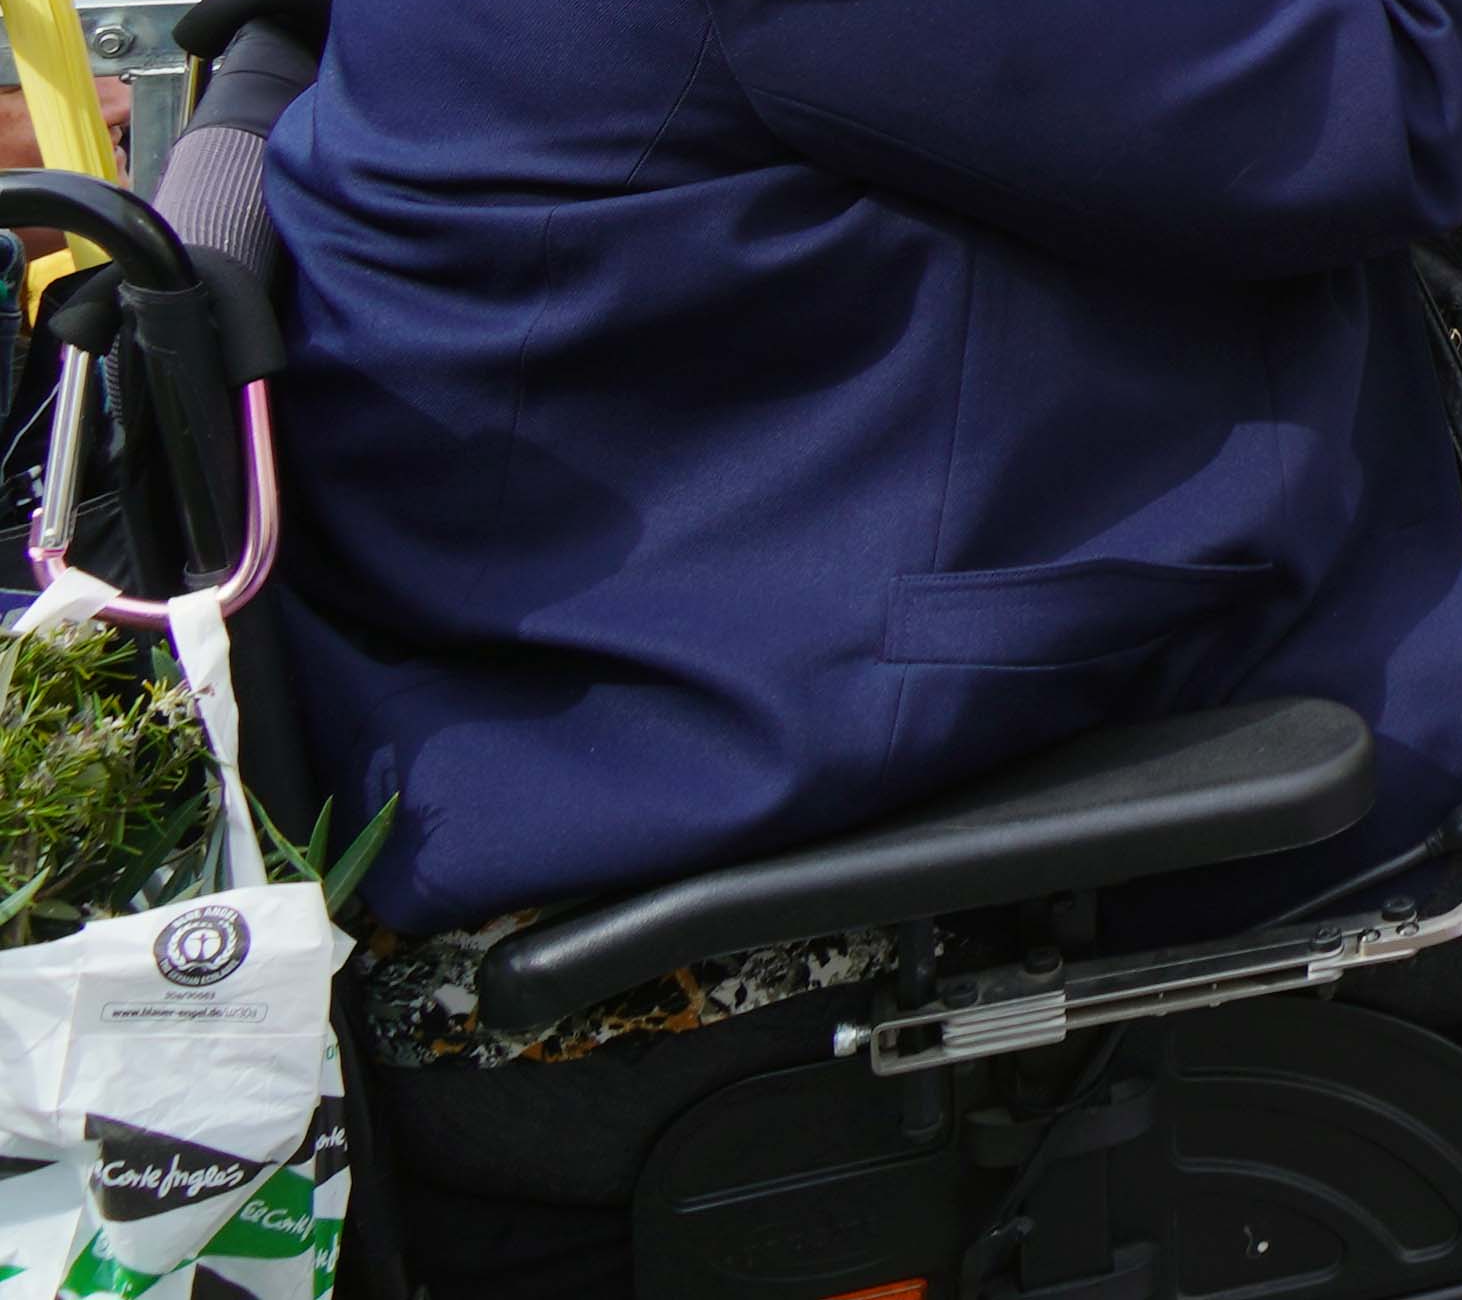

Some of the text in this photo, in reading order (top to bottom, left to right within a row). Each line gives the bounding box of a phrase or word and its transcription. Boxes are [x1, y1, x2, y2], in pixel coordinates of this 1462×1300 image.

[204, 906, 238, 922] ANGEL
[102, 1160, 160, 1188] Corte
[158, 1154, 244, 1199] Inglés
